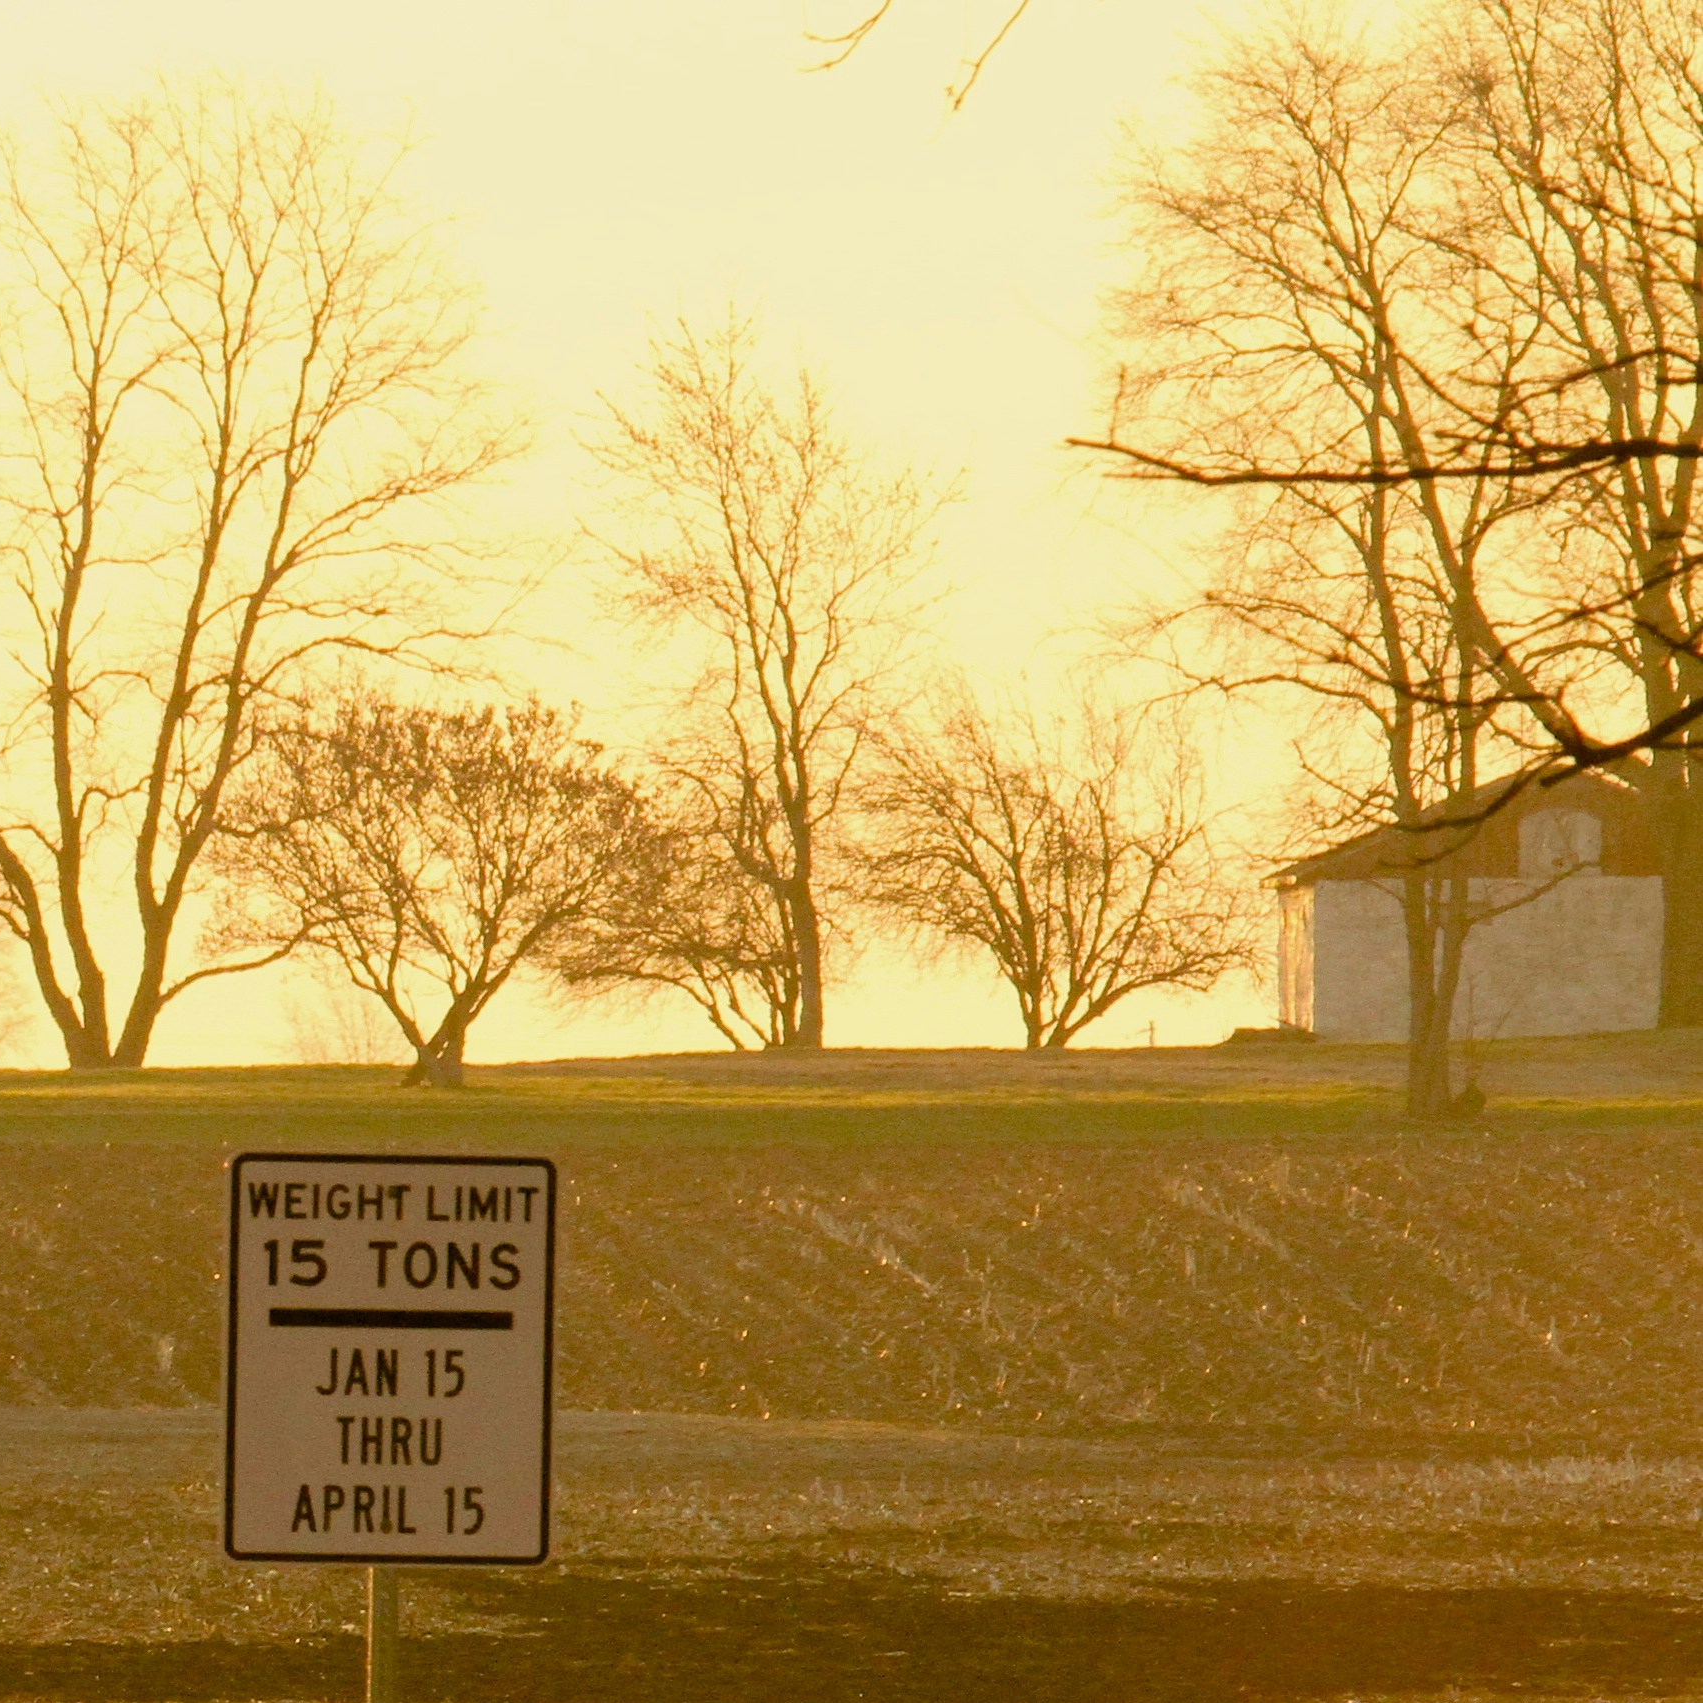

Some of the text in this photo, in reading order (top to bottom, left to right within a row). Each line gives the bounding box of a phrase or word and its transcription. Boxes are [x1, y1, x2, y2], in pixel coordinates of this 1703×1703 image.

[248, 1183, 539, 1223] WEIGHT LIMIT
[264, 1240, 521, 1290] 15 TONS
[316, 1348, 466, 1397] JAN 15
[337, 1417, 443, 1465] THRU
[292, 1485, 486, 1535] APRIL 15
